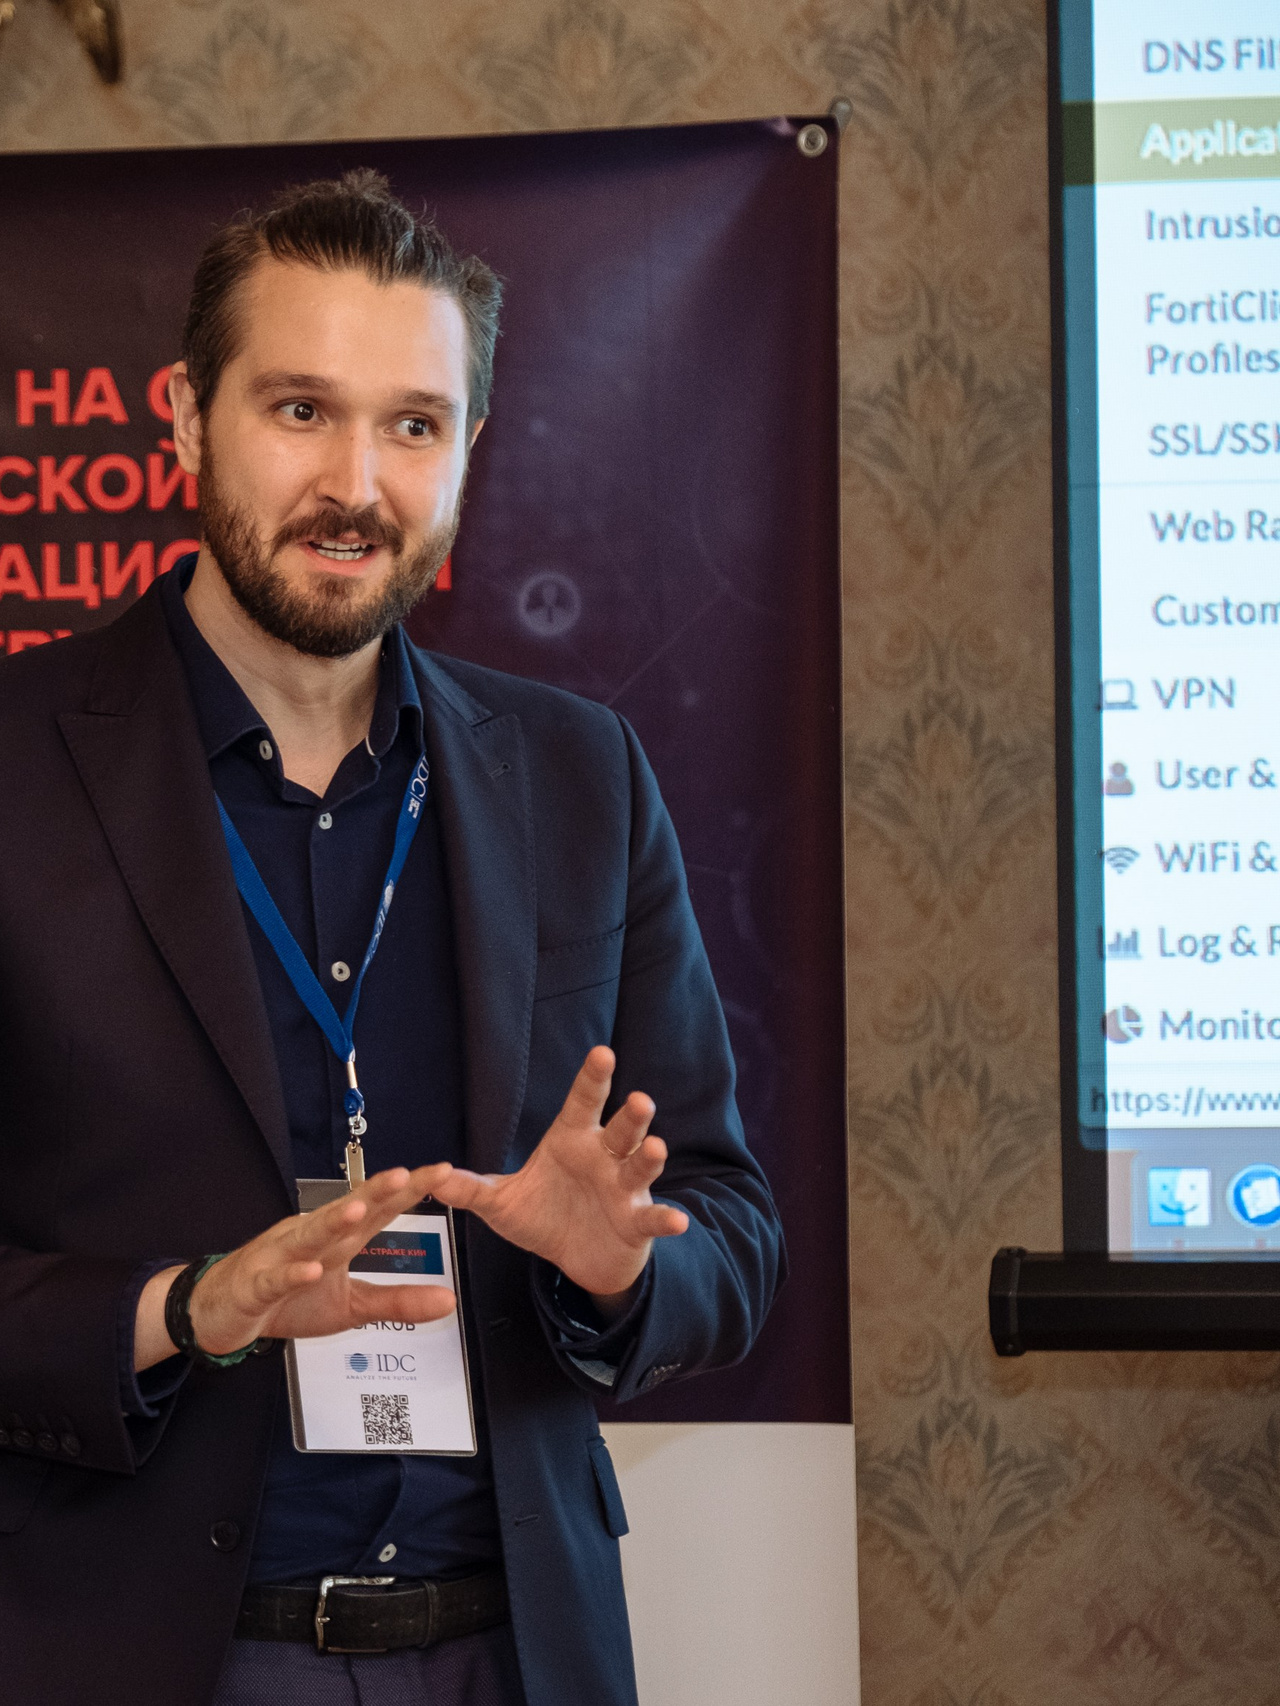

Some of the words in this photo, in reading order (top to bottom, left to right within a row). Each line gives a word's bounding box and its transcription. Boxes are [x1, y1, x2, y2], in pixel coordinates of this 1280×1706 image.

[1142, 38, 1225, 73] DNS
[1233, 37, 1280, 71] Fil
[1140, 119, 1280, 165] Applica
[1145, 290, 1280, 324] FortiCli
[1146, 342, 1280, 375] Profiles
[16, 367, 130, 425] НА
[1150, 508, 1235, 542] Web
[1152, 677, 1235, 709] VPN
[1155, 758, 1239, 789] User
[1248, 757, 1277, 788] &
[1154, 840, 1240, 872] WiFi
[1249, 840, 1278, 873] &
[1158, 926, 1221, 964] Log
[1230, 924, 1259, 957] &
[370, 1247, 406, 1256] СТРАЖЕ
[376, 1353, 416, 1373] IDC
